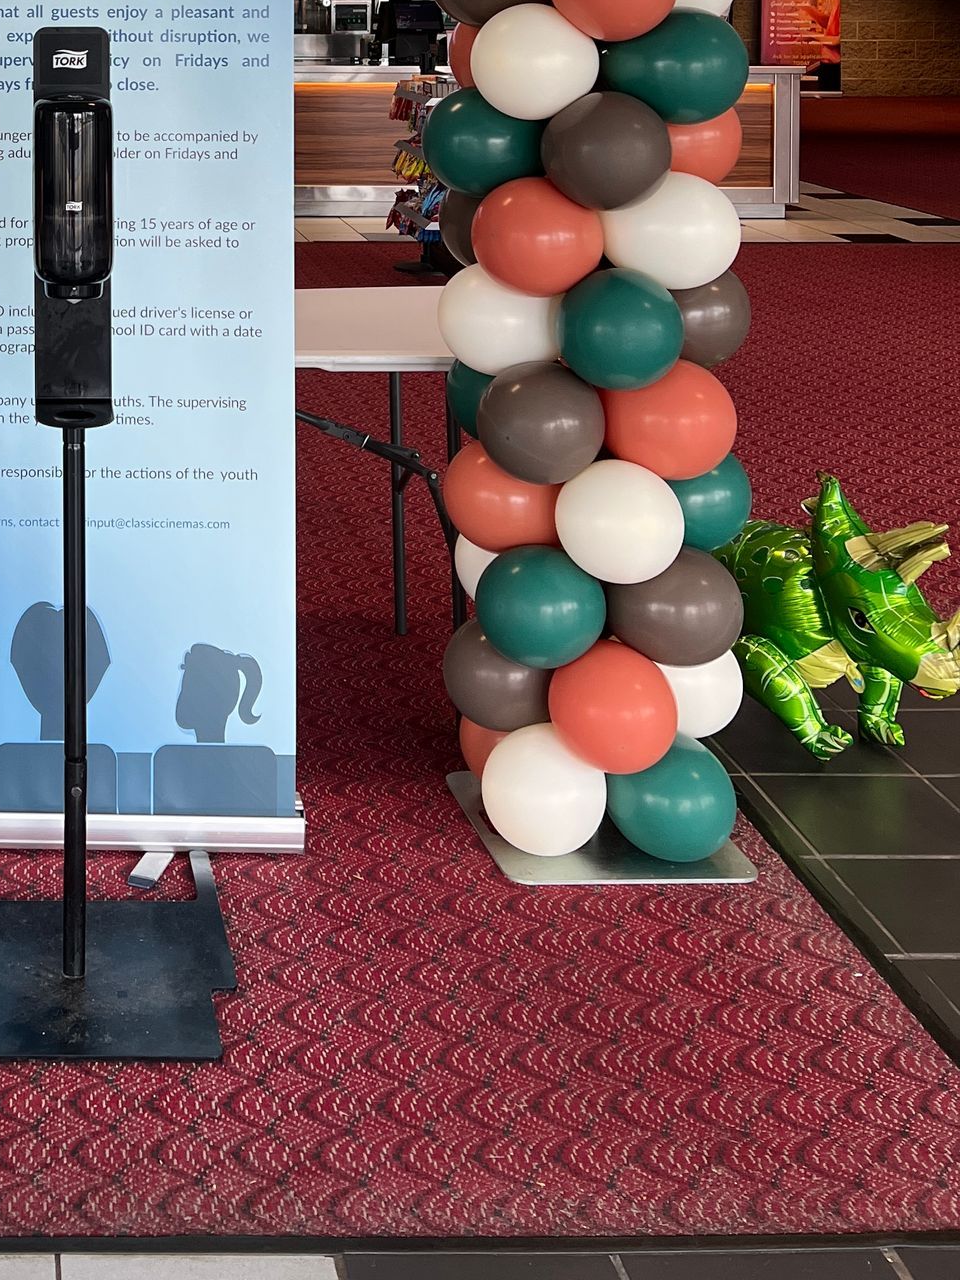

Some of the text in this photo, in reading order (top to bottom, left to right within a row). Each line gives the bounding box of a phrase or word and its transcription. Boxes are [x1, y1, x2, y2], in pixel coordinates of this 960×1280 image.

[26, 4, 43, 19] all
[51, 6, 99, 21] guests
[106, 4, 148, 21] enjoy
[155, 8, 163, 19] a
[171, 5, 235, 21] pleasant
[242, 5, 269, 19] and
[160, 29, 270, 46] disruption, we
[54, 56, 85, 66] TORK
[117, 77, 159, 91] close.
[19, 517, 60, 527] contact
